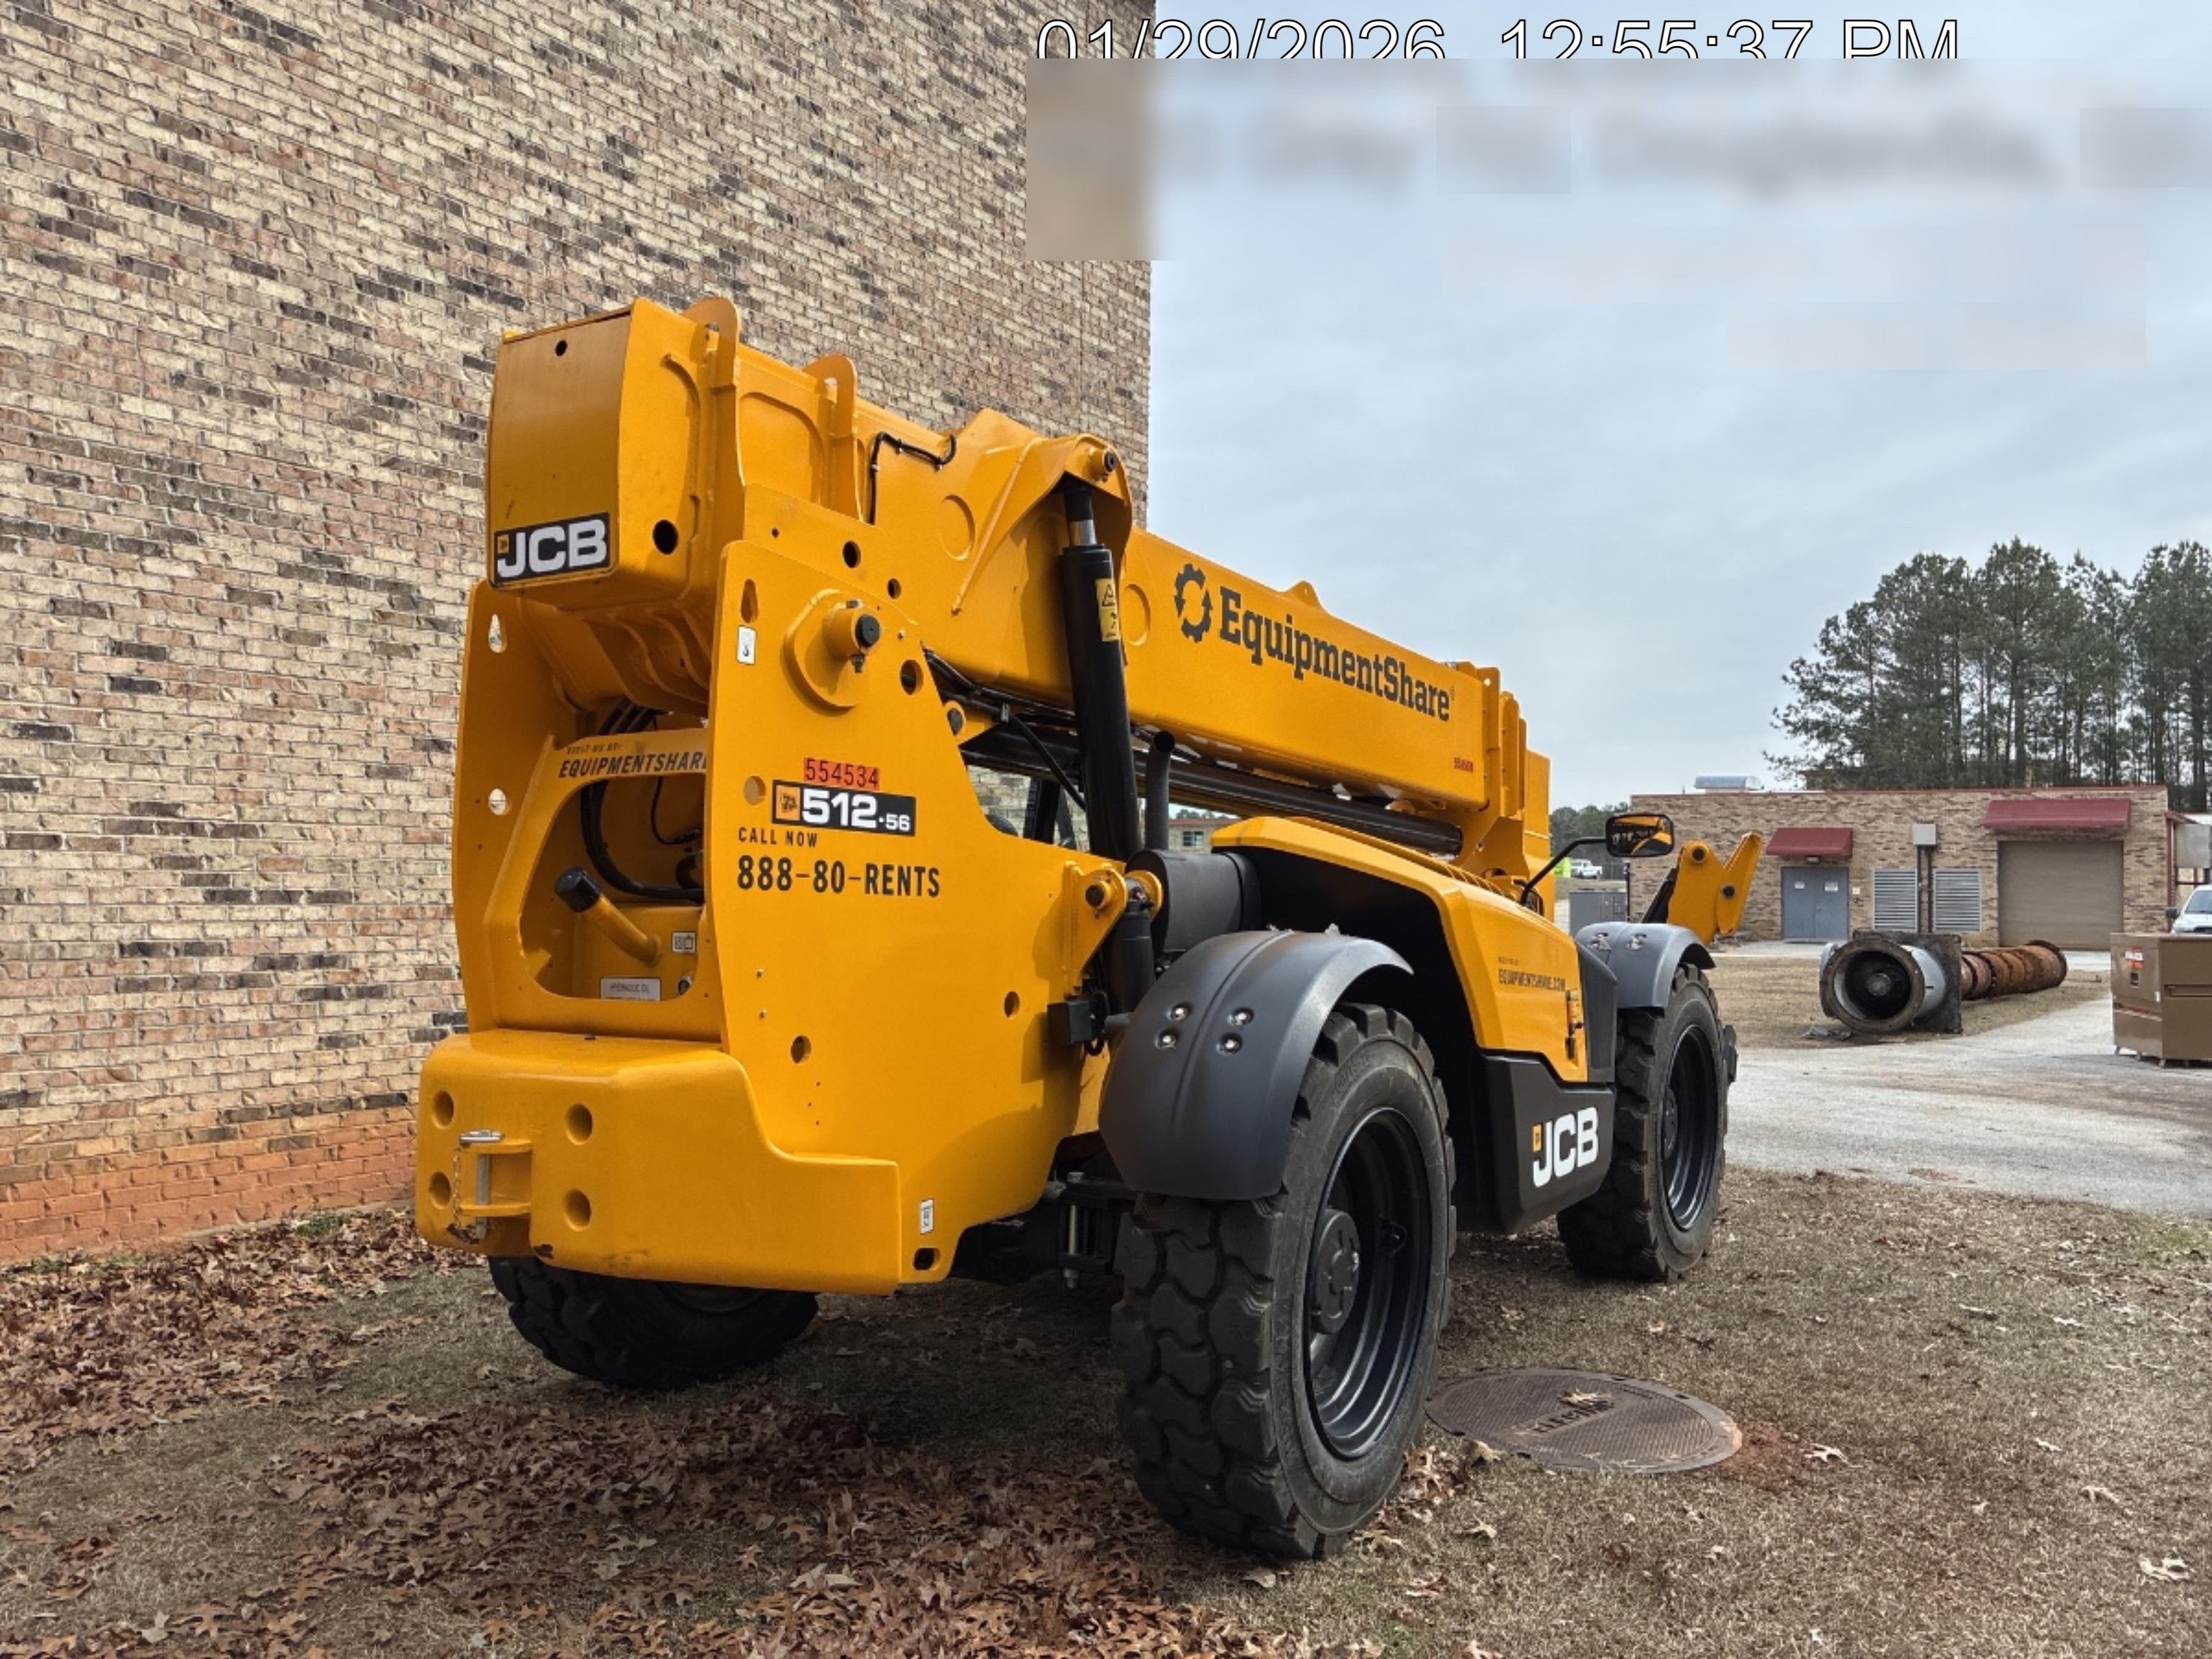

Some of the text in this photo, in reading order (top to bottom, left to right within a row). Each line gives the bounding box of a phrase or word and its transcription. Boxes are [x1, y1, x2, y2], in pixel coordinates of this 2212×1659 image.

[496, 519, 607, 578] JCB
[1220, 586, 1450, 722] EquipmentShare
[805, 758, 879, 787] 554534
[738, 827, 818, 848] CALL NOW
[737, 854, 940, 898] 888-80-RENTS
[1532, 1107, 1599, 1188] JCB
